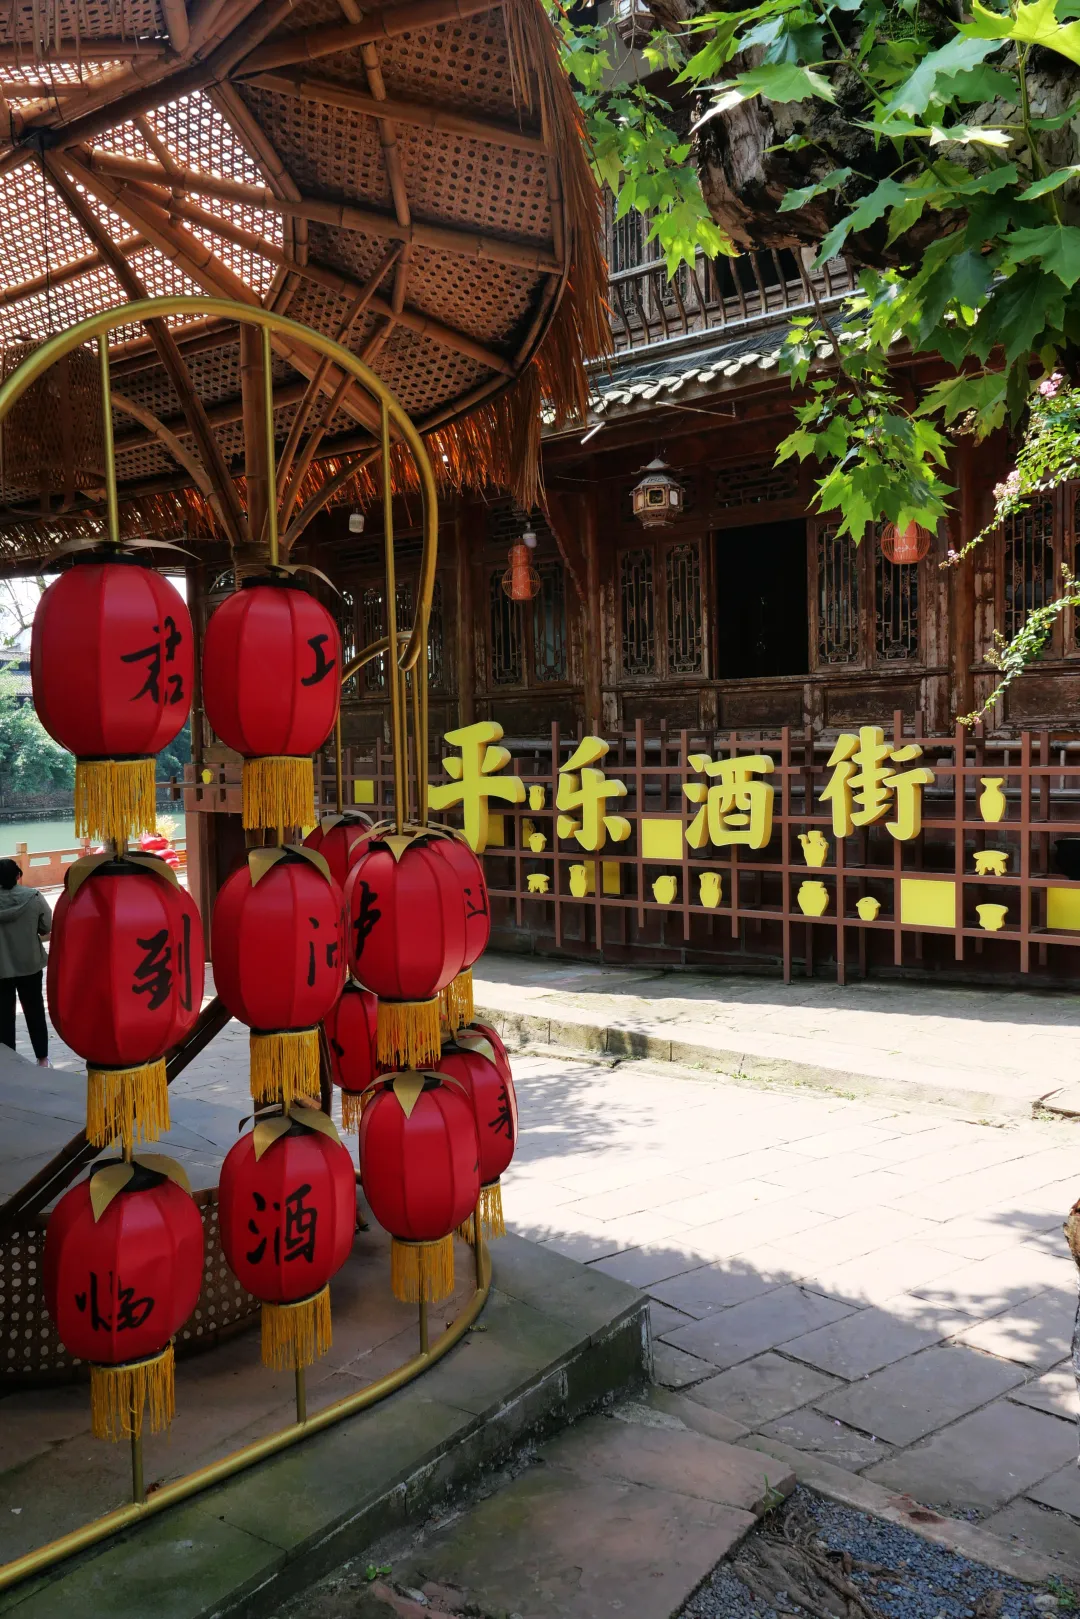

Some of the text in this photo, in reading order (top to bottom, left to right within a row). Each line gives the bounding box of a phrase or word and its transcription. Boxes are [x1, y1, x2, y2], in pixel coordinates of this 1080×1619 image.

[427, 720, 935, 854] 平乐酒街
[131, 913, 193, 1012] 到
[246, 1183, 318, 1266] 酒
